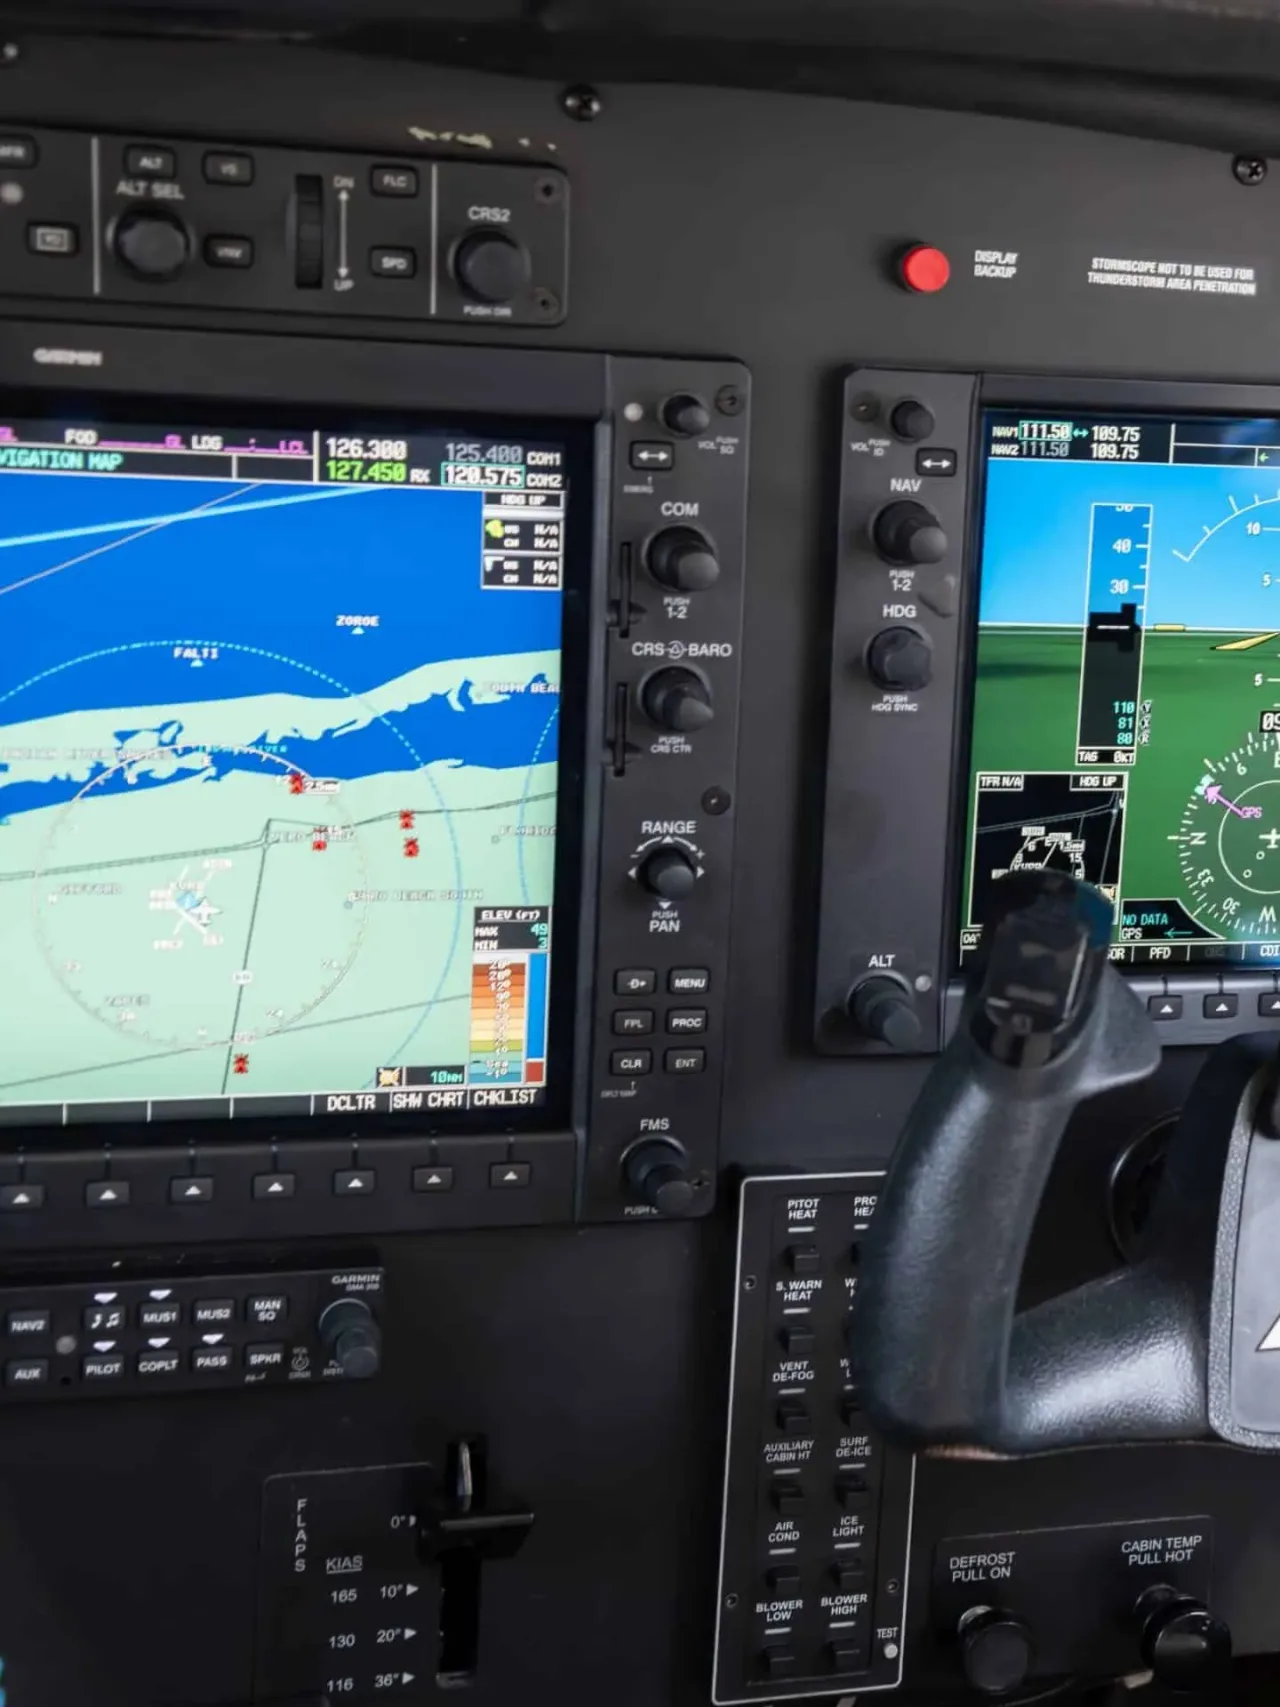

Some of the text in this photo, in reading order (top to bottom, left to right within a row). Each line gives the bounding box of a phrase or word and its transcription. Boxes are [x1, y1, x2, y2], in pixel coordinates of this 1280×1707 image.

[140, 156, 162, 169] ALT
[117, 181, 184, 199] ALT SEL
[467, 206, 511, 223] CRS2
[974, 250, 1018, 265] DISPLAY
[974, 264, 1016, 279] BACKUP
[1092, 257, 1254, 280] STORMSCOPE NOT TO BE USED FOR
[1087, 271, 1257, 295] THUNDERSTORM AREA PENETRATION
[992, 423, 1070, 439] NAV1 111.50
[1091, 425, 1141, 442] 109.75
[327, 438, 407, 460] 126.300
[446, 443, 562, 465] 125.400 COM1
[991, 441, 1069, 457] NAV2 111.50
[1090, 443, 1140, 459] 109.75
[88, 452, 123, 470] MAP
[327, 460, 431, 483] 127.450 RX
[446, 465, 562, 488] 120.575 COM2
[890, 478, 922, 492] NAV
[661, 502, 699, 516] COM
[892, 579, 912, 591] 1-2
[667, 606, 687, 619] 1-2
[882, 604, 917, 618] HDG
[632, 642, 664, 657] CRS
[688, 644, 732, 657] BARO
[1113, 701, 1135, 714] 110
[980, 776, 1022, 787] TFR N/A
[1080, 776, 1116, 787] HDG UP
[1241, 807, 1262, 818] GPS
[641, 821, 696, 834] RANGE
[652, 911, 678, 919] PUSH
[1122, 913, 1169, 925] NO DATA
[475, 923, 548, 937] MAX 49
[649, 920, 681, 932] PAN
[1122, 929, 1142, 940] GPS
[1150, 947, 1171, 959] PFD
[1260, 944, 1280, 957] CDI
[868, 954, 895, 967] ALT
[674, 978, 705, 988] MENU
[624, 1019, 644, 1028] FPL
[672, 1018, 702, 1028] PROC
[621, 1059, 642, 1069] CLR
[675, 1058, 697, 1068] ENT
[327, 1094, 376, 1112] DCLTR
[393, 1092, 465, 1108] SHW CHRT
[474, 1089, 537, 1106] CHKLIST
[640, 1118, 670, 1131] FMS
[787, 1199, 820, 1209] PITOT
[788, 1209, 818, 1220] HEAT
[331, 1274, 380, 1285] GARMIN
[788, 1280, 822, 1291] WARN
[783, 1291, 813, 1301] HEAT
[254, 1300, 281, 1312] MAN
[143, 1311, 177, 1323] MUS1
[197, 1308, 231, 1321] MUS2
[11, 1320, 46, 1332] NAV2
[139, 1359, 179, 1372] COPLT
[196, 1355, 227, 1367] PASS
[250, 1353, 282, 1365] SPKR
[86, 1363, 121, 1375] PILOT
[779, 1361, 809, 1371] VENT
[15, 1367, 41, 1380] AUX
[772, 1371, 815, 1383] DE-FOG
[764, 1440, 815, 1453] AUXILIARY
[840, 1437, 868, 1447] SURF
[766, 1450, 811, 1463] CABIN HT
[836, 1446, 872, 1458] DE-ICE
[775, 1521, 794, 1531] AIR
[840, 1516, 858, 1525] ICE
[295, 1498, 307, 1572] FLAPS
[768, 1531, 800, 1543] COND
[832, 1525, 864, 1537] LIGHT
[1122, 1535, 1202, 1554] CABIN TEMP
[326, 1556, 363, 1572] KIAS
[950, 1551, 1016, 1570] DEFROST
[1128, 1549, 1194, 1566] PULL HOT
[952, 1566, 1012, 1583] PULL ON
[331, 1589, 357, 1604] 165
[821, 1594, 868, 1607] BLOWER
[756, 1600, 803, 1613] BLOWER
[831, 1605, 857, 1615] HIGH
[767, 1611, 792, 1622] LOW
[877, 1627, 898, 1638] TEST
[329, 1634, 355, 1649] 130
[327, 1678, 353, 1693] 116
